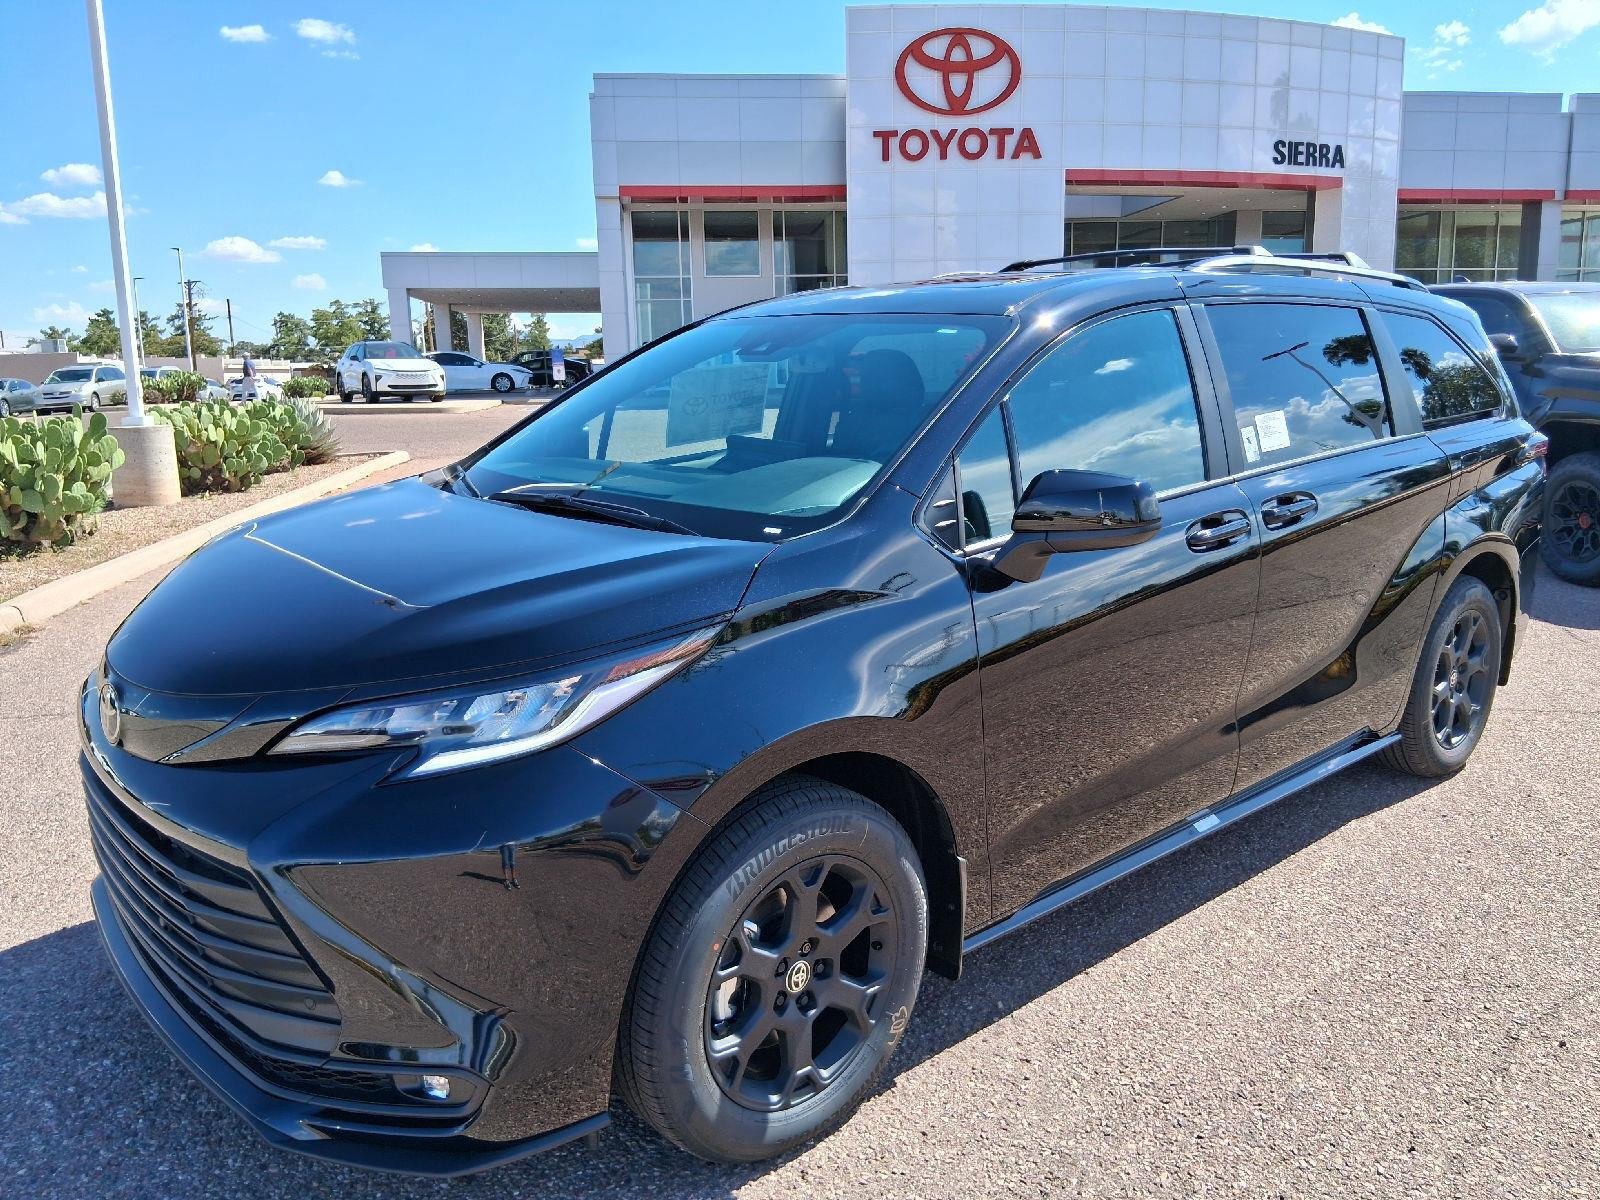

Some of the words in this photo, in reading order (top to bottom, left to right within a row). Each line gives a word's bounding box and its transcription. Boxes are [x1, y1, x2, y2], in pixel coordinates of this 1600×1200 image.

[873, 127, 1042, 162] TOYOTA
[1272, 139, 1345, 169] SIERRA
[725, 814, 851, 903] BRIDGESTONE
